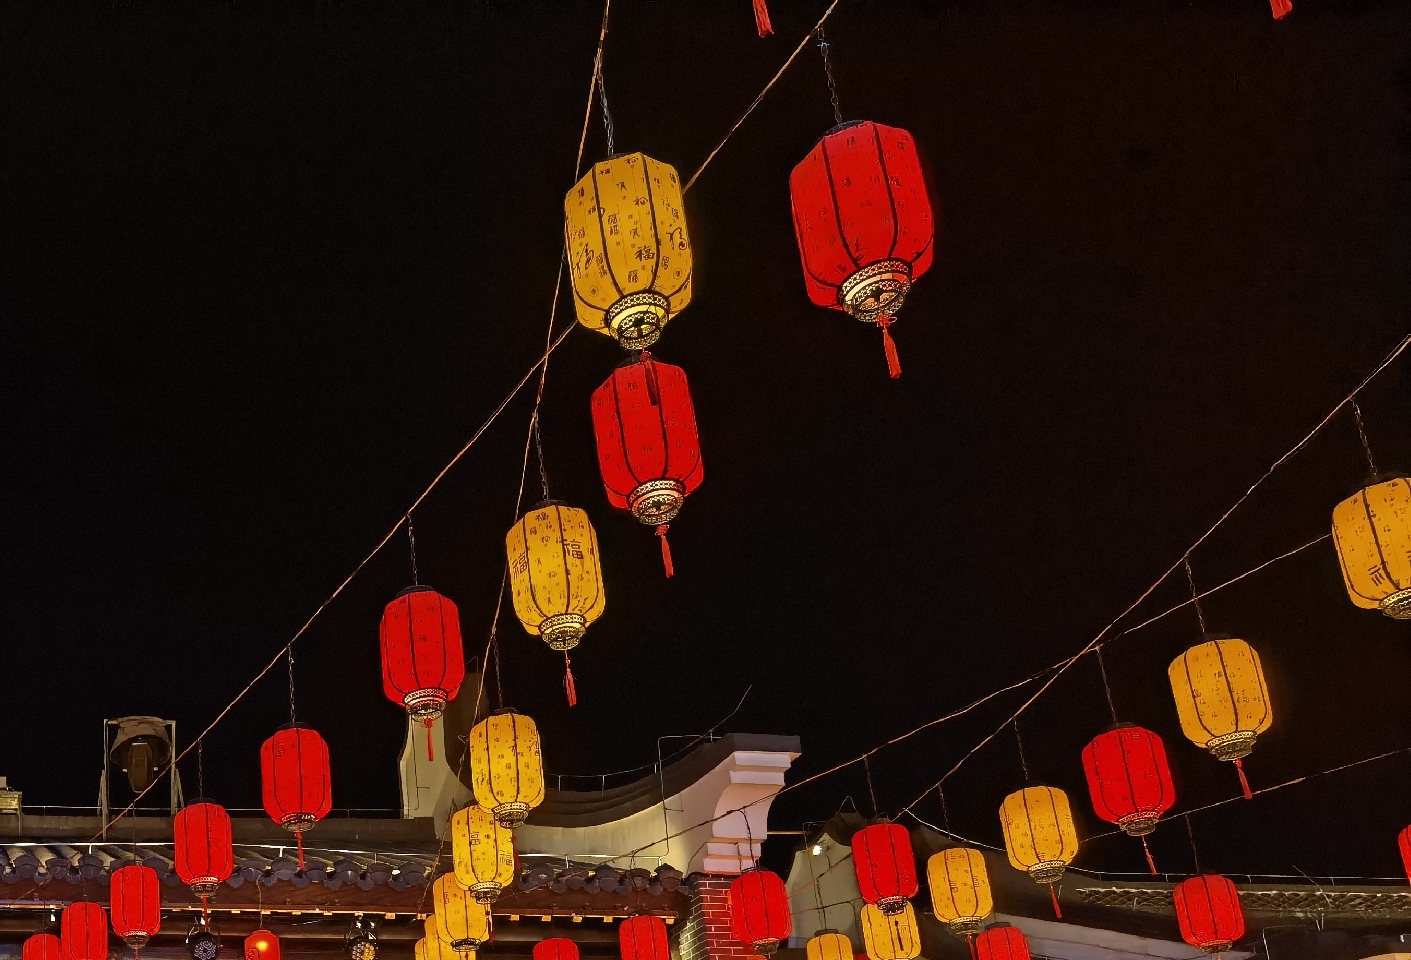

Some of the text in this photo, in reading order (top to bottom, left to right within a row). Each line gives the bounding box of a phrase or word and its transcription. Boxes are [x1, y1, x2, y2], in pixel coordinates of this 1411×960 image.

[635, 245, 655, 261] 福
[562, 538, 585, 560] 福
[512, 550, 528, 580] 福
[500, 849, 513, 867] 福
